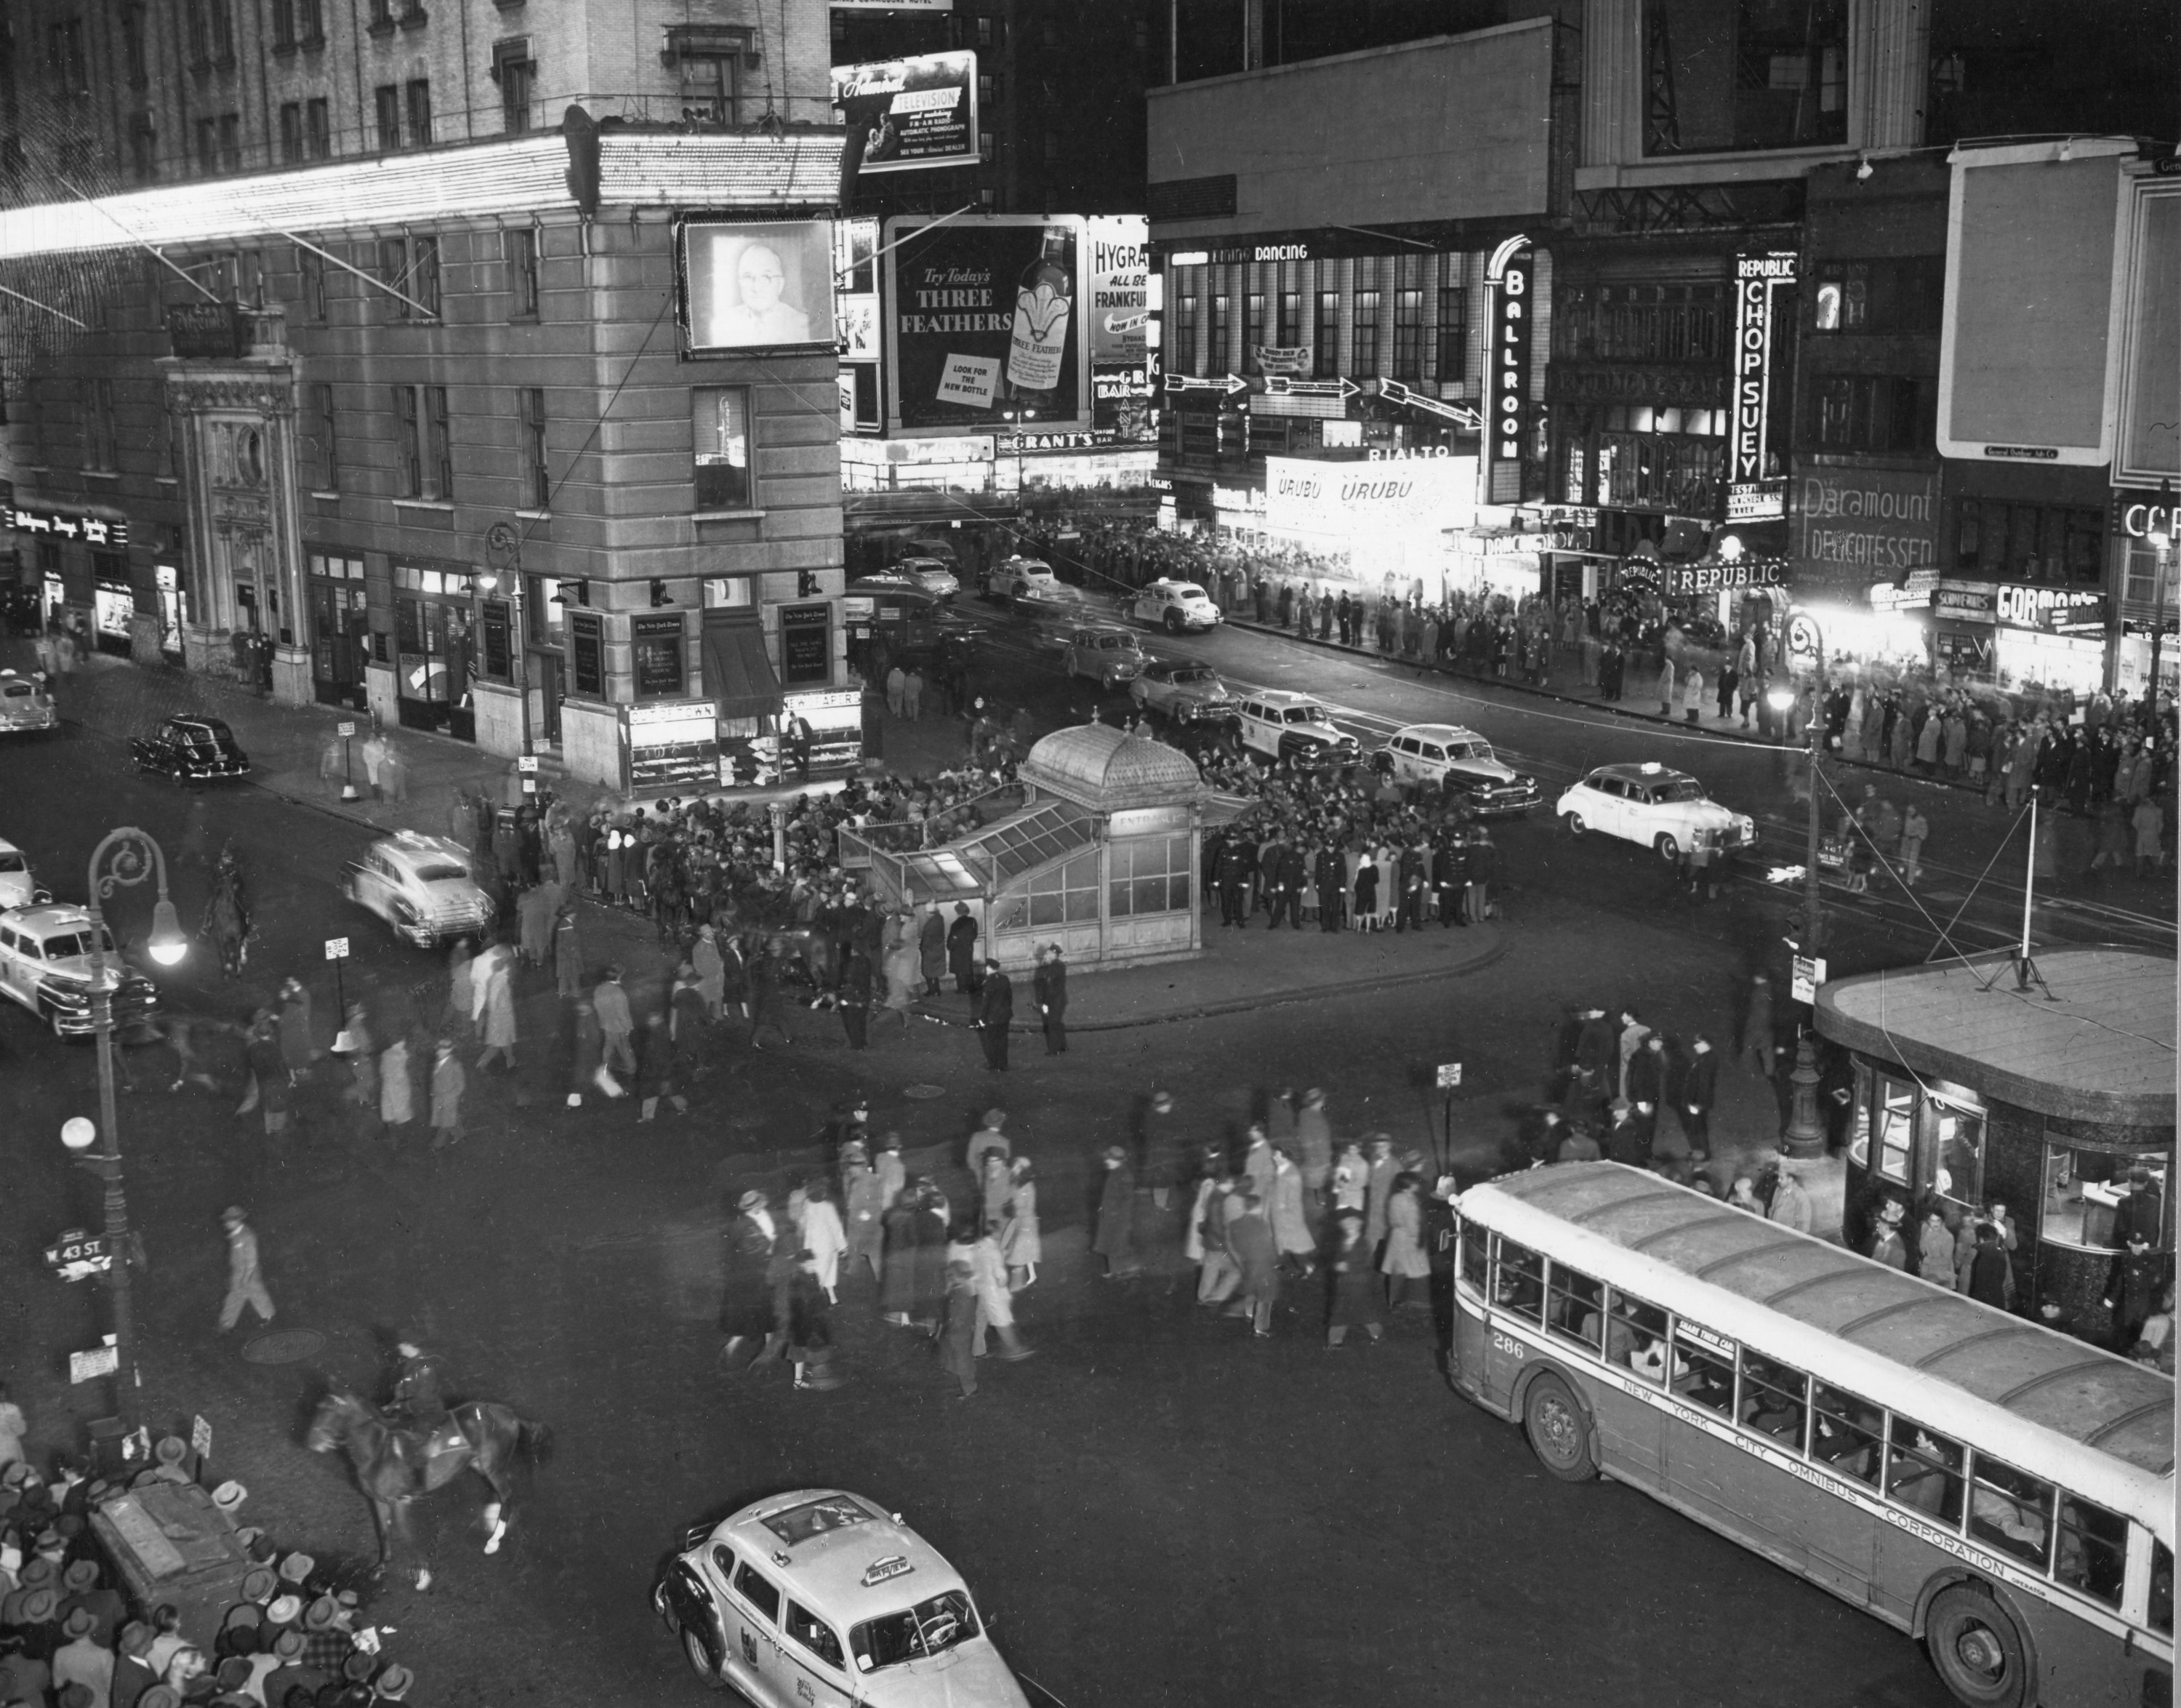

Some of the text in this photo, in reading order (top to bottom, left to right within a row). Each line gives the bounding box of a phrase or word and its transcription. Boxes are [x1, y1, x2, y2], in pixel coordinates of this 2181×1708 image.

[843, 73, 905, 97] Admiral
[899, 91, 955, 109] TELEVISION
[1256, 244, 1308, 260] DANCING
[924, 268, 991, 286] Try Today's
[1738, 260, 1795, 277] REPUBLIC
[1109, 275, 1129, 286] ALL
[916, 289, 992, 308] THREE
[901, 313, 1012, 334] FEATHERS
[1109, 320, 1128, 332] NOW
[1129, 318, 1139, 328] IN
[1011, 335, 1061, 354] THREE FEATHERS
[973, 367, 987, 376] FOR
[1502, 270, 1525, 457] BALLROOM
[962, 375, 975, 384] THE
[1740, 281, 1764, 477] CHOP SUEY
[962, 385, 987, 396] BOTTLE
[1098, 385, 1132, 399] BAR
[1012, 433, 1093, 449] GRANT'S
[1369, 445, 1449, 461] RIALTO
[1279, 478, 1321, 498] URUBU
[1341, 481, 1413, 500] URUBU
[1802, 478, 1932, 534] Paramount
[1812, 529, 1932, 569] DELICATESSEN
[1624, 566, 1657, 583] REPUBLIC
[1682, 565, 1780, 590] REPUBLIC
[675, 705, 712, 718] TOWN
[47, 1250, 60, 1263] W.
[63, 1246, 81, 1259] 43
[1679, 1320, 1700, 1336] SHARE
[1700, 1329, 1719, 1345] THEIR
[1494, 1331, 1525, 1360] 286
[1623, 1379, 2047, 1597] NEW YORK CITY OMNIBUS CORPORATION OPERATOR
